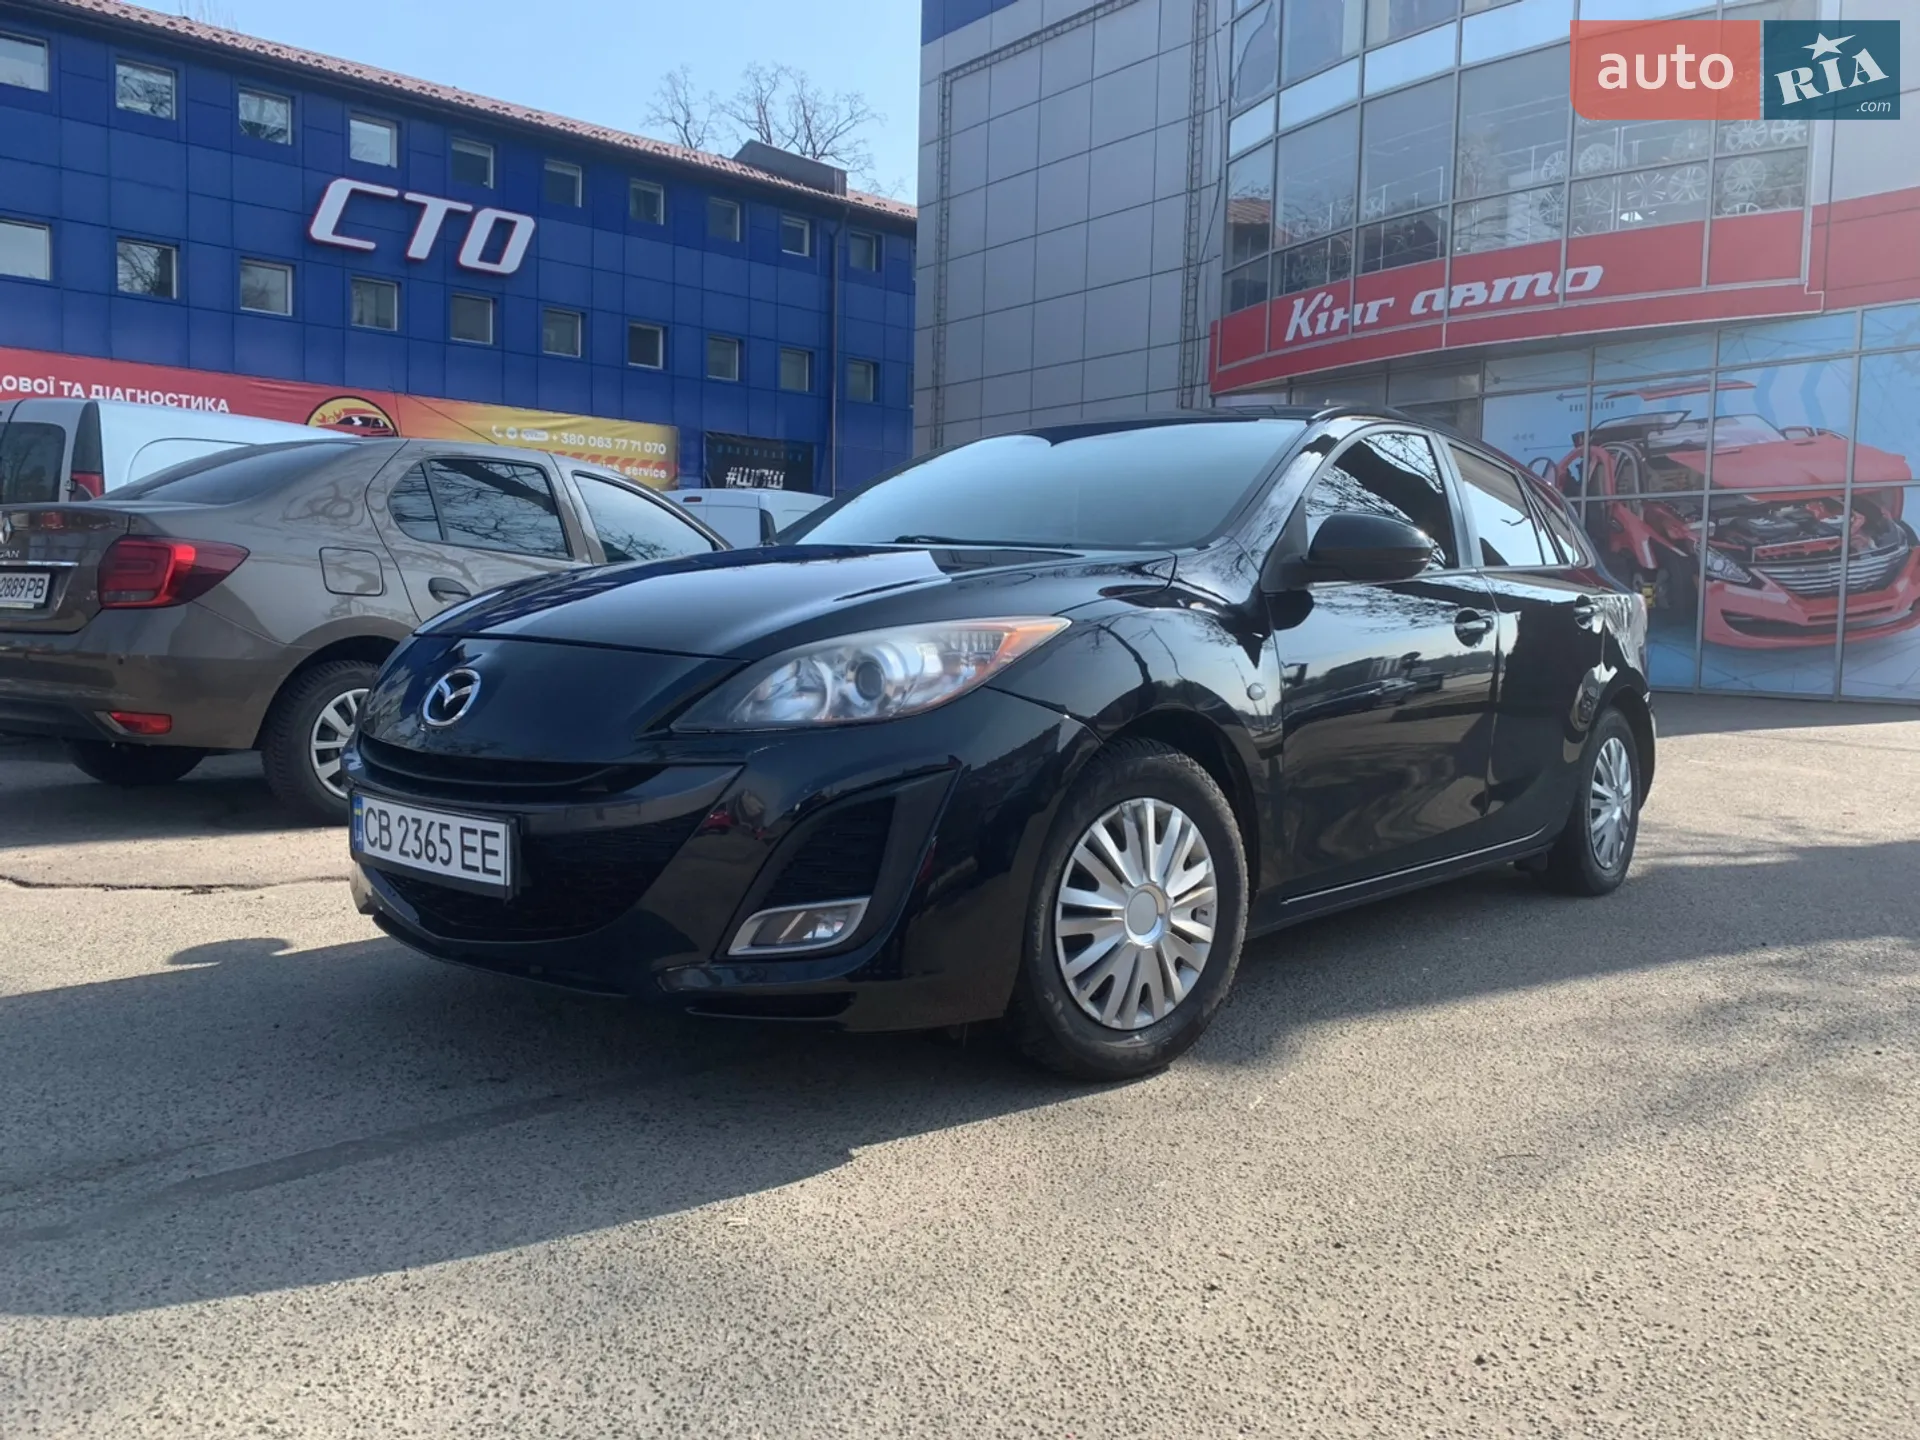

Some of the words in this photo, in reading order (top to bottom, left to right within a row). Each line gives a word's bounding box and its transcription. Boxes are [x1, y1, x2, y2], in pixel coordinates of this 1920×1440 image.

[309, 177, 536, 275] СТО
[1285, 291, 1395, 342] Кінг
[1410, 265, 1604, 316] авто
[0, 375, 55, 395] ОВОЇ
[59, 381, 86, 399] ТА
[90, 384, 230, 414] ДІАГНОСТИКА
[614, 438, 628, 451] 77
[644, 441, 667, 455] 070
[364, 807, 392, 852] CB
[397, 815, 453, 867] 2365
[460, 826, 502, 877] EE
